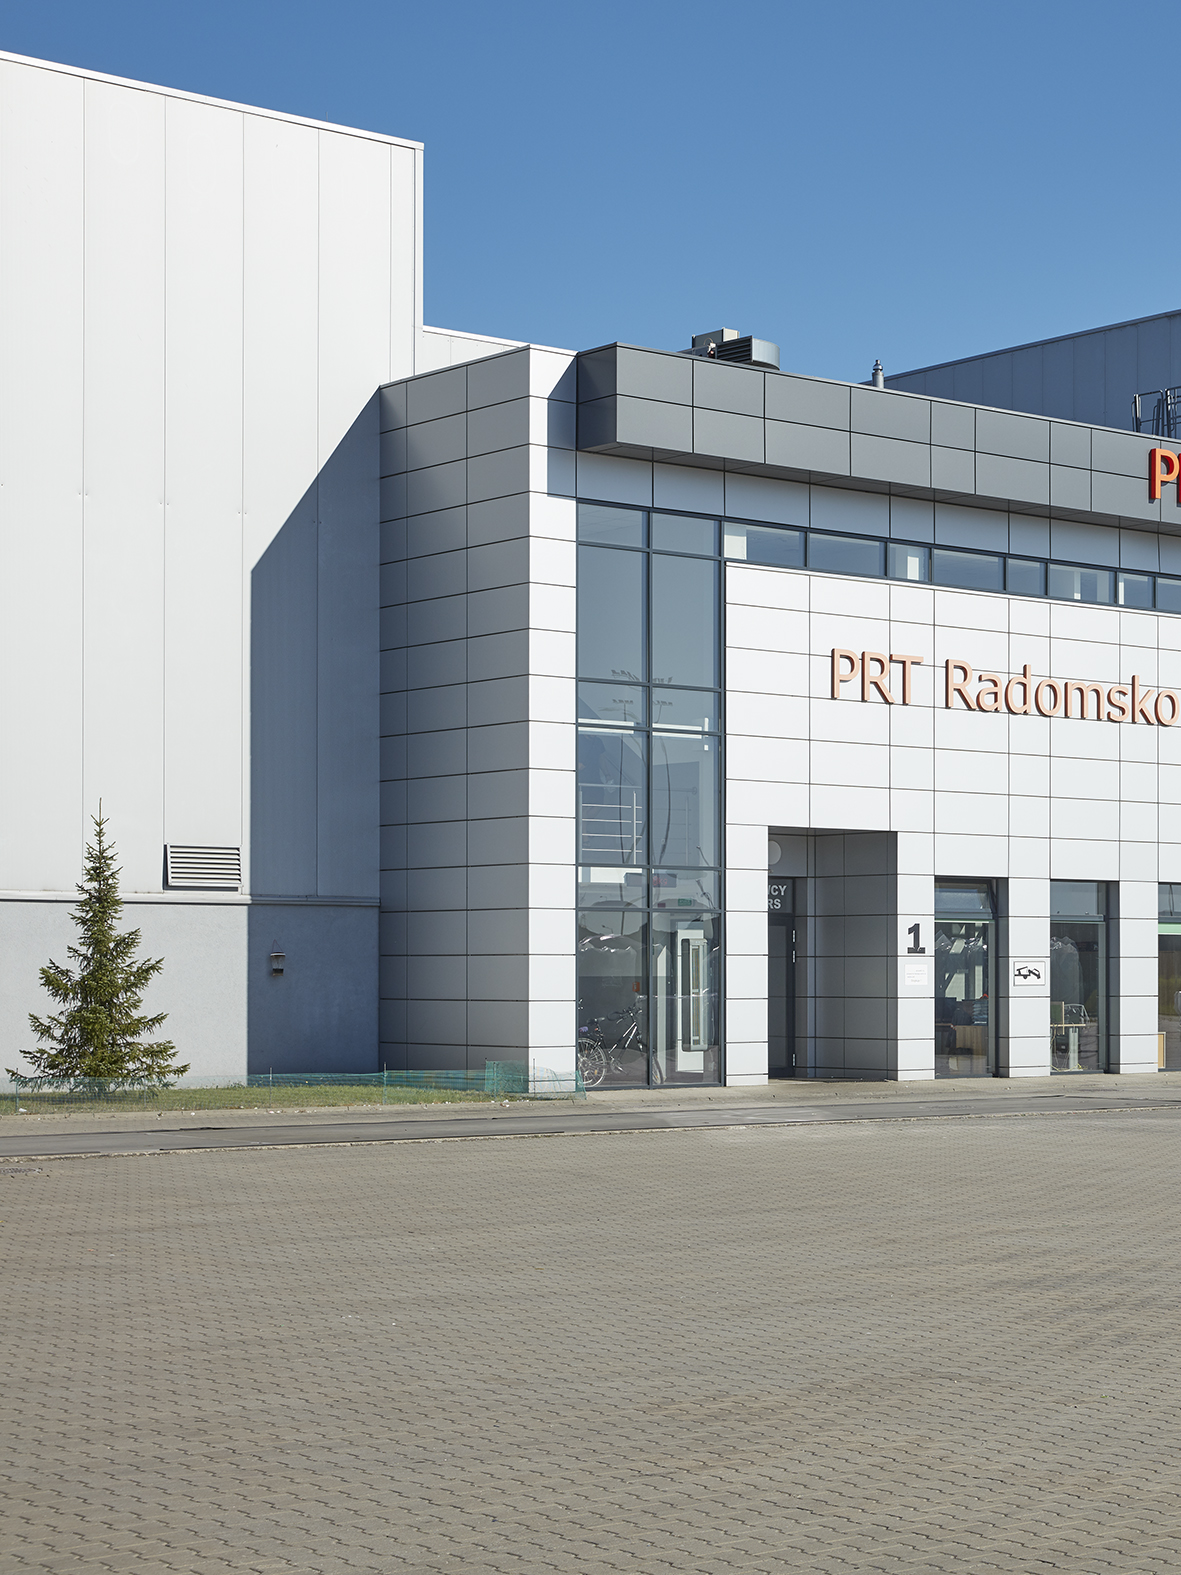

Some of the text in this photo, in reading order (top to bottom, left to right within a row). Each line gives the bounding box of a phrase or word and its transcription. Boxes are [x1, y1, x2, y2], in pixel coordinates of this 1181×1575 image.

[831, 648, 1180, 726] PRT Radomsko
[768, 884, 787, 896] CY
[907, 923, 926, 954] 1
